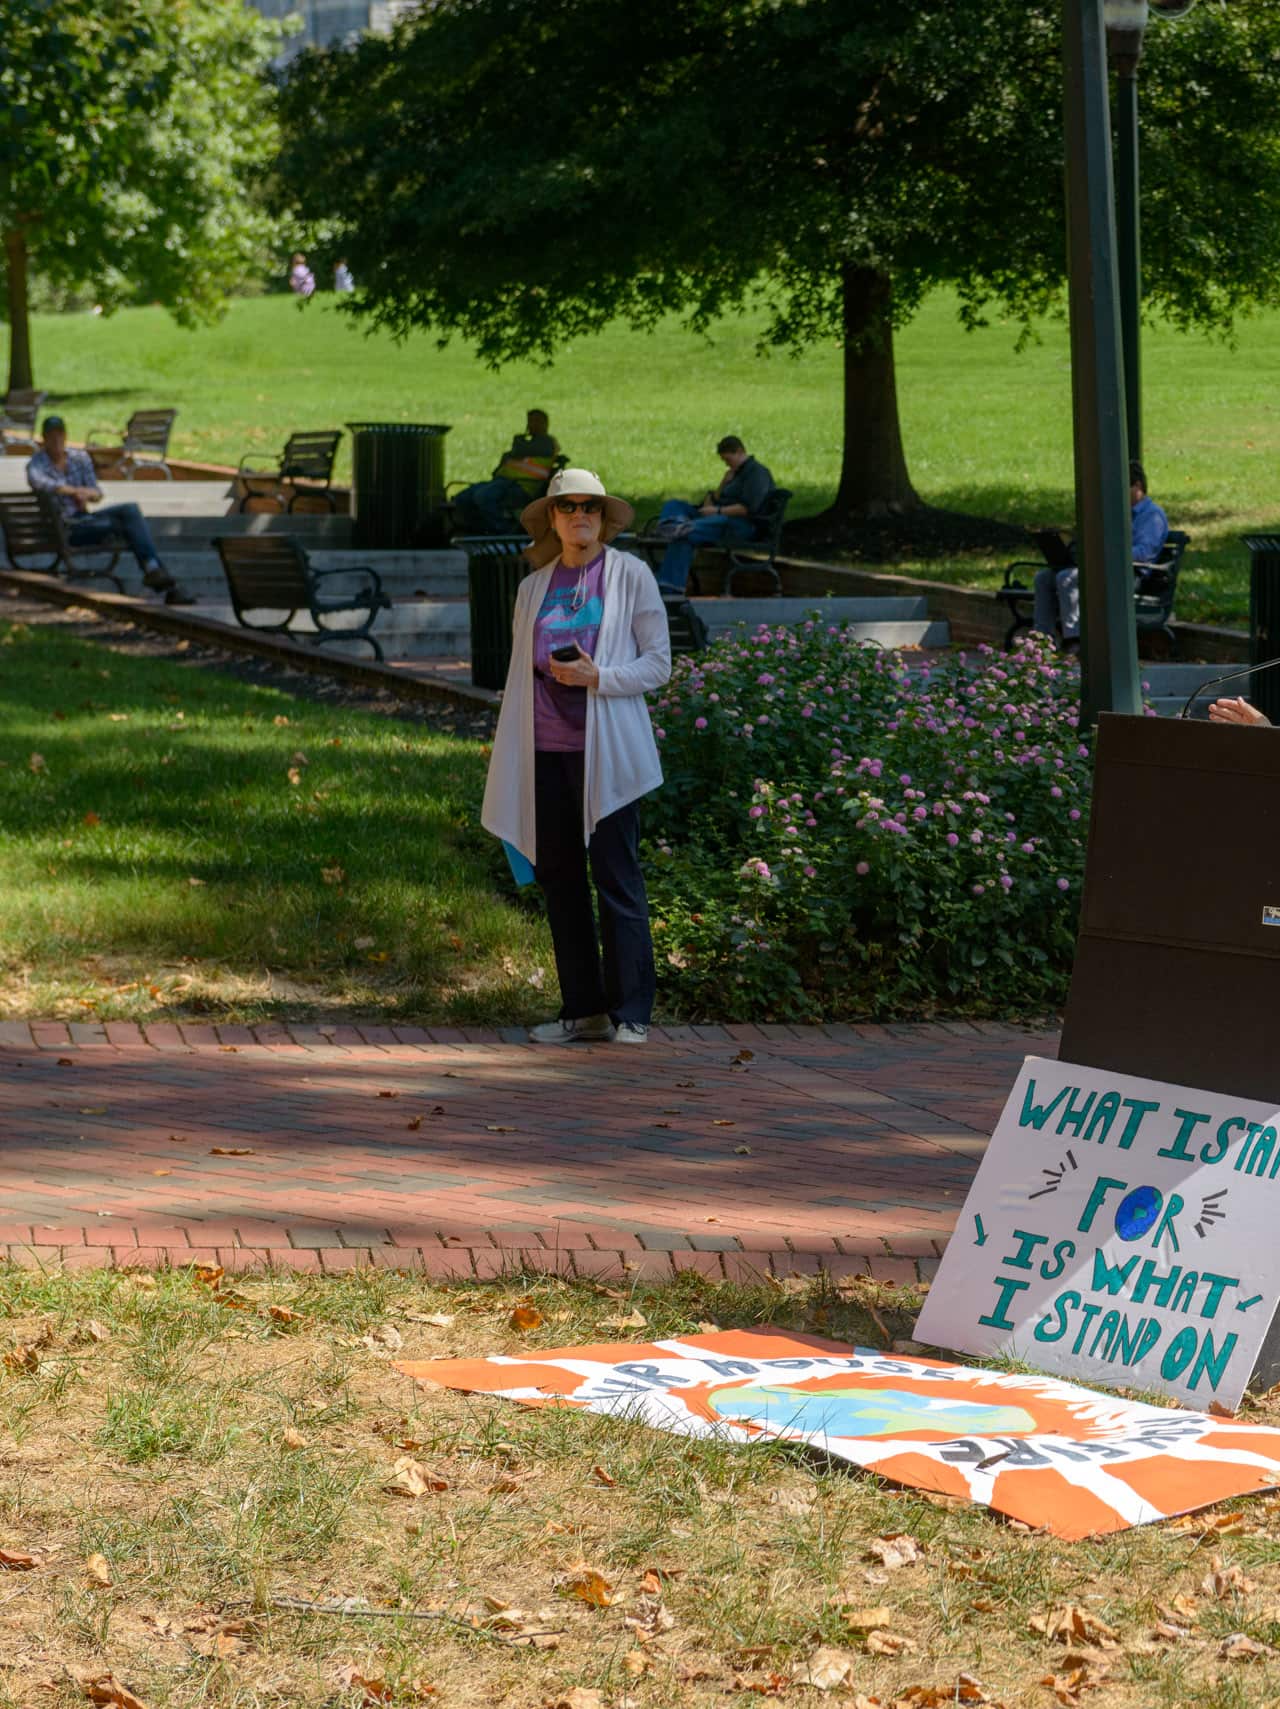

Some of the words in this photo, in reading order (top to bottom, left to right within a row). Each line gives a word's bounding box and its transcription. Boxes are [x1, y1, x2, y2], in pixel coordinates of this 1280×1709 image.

[1018, 1078, 1161, 1150] WHAT
[1156, 1105, 1212, 1162] I
[1077, 1176, 1185, 1253] FOR
[1002, 1229, 1076, 1280] IS
[1091, 1247, 1240, 1319] WHAT
[977, 1276, 1031, 1332] I
[1033, 1290, 1162, 1367] STAND
[1160, 1326, 1239, 1392] ON
